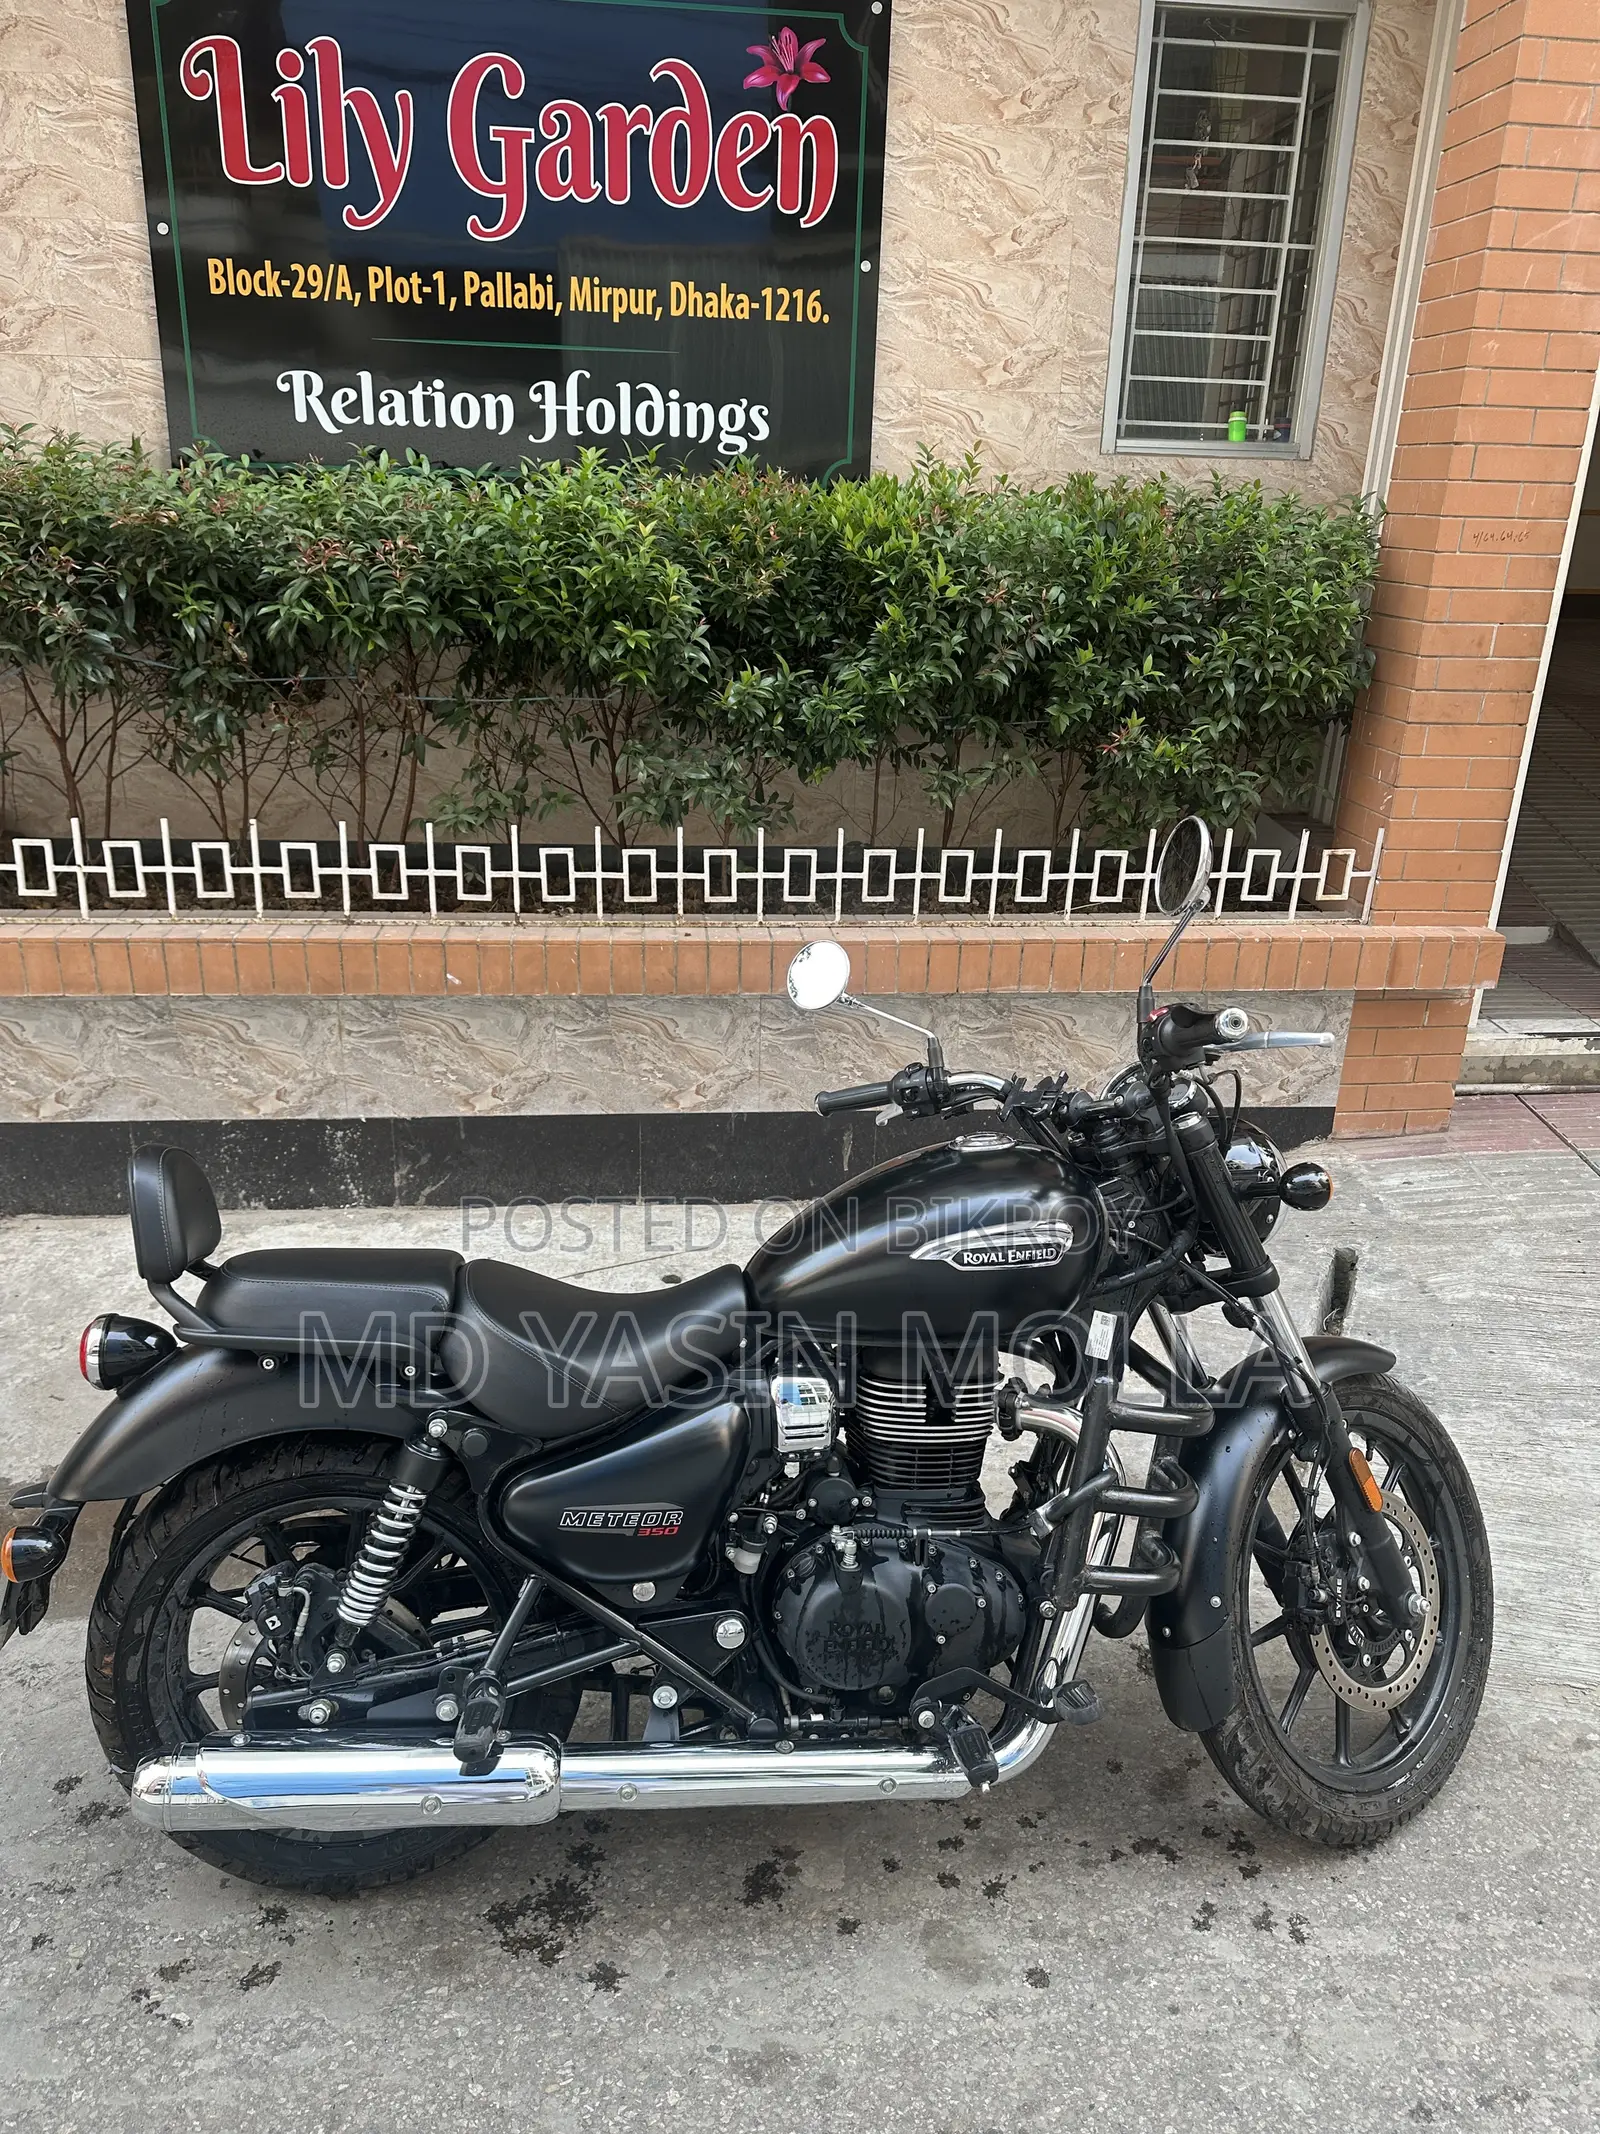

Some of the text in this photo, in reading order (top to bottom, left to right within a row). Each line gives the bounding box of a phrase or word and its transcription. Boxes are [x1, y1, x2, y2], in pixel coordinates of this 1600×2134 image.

[180, 35, 839, 241] Lily Garden
[208, 258, 829, 324] Block-29/A, Plot-1, Pallabi, Mirpur, Dhaka-1216.
[277, 370, 770, 455] Relation Holdings
[963, 1247, 1057, 1264] ROYAL ENFIELD
[560, 1510, 684, 1527] METEOR
[637, 1526, 680, 1537] 350
